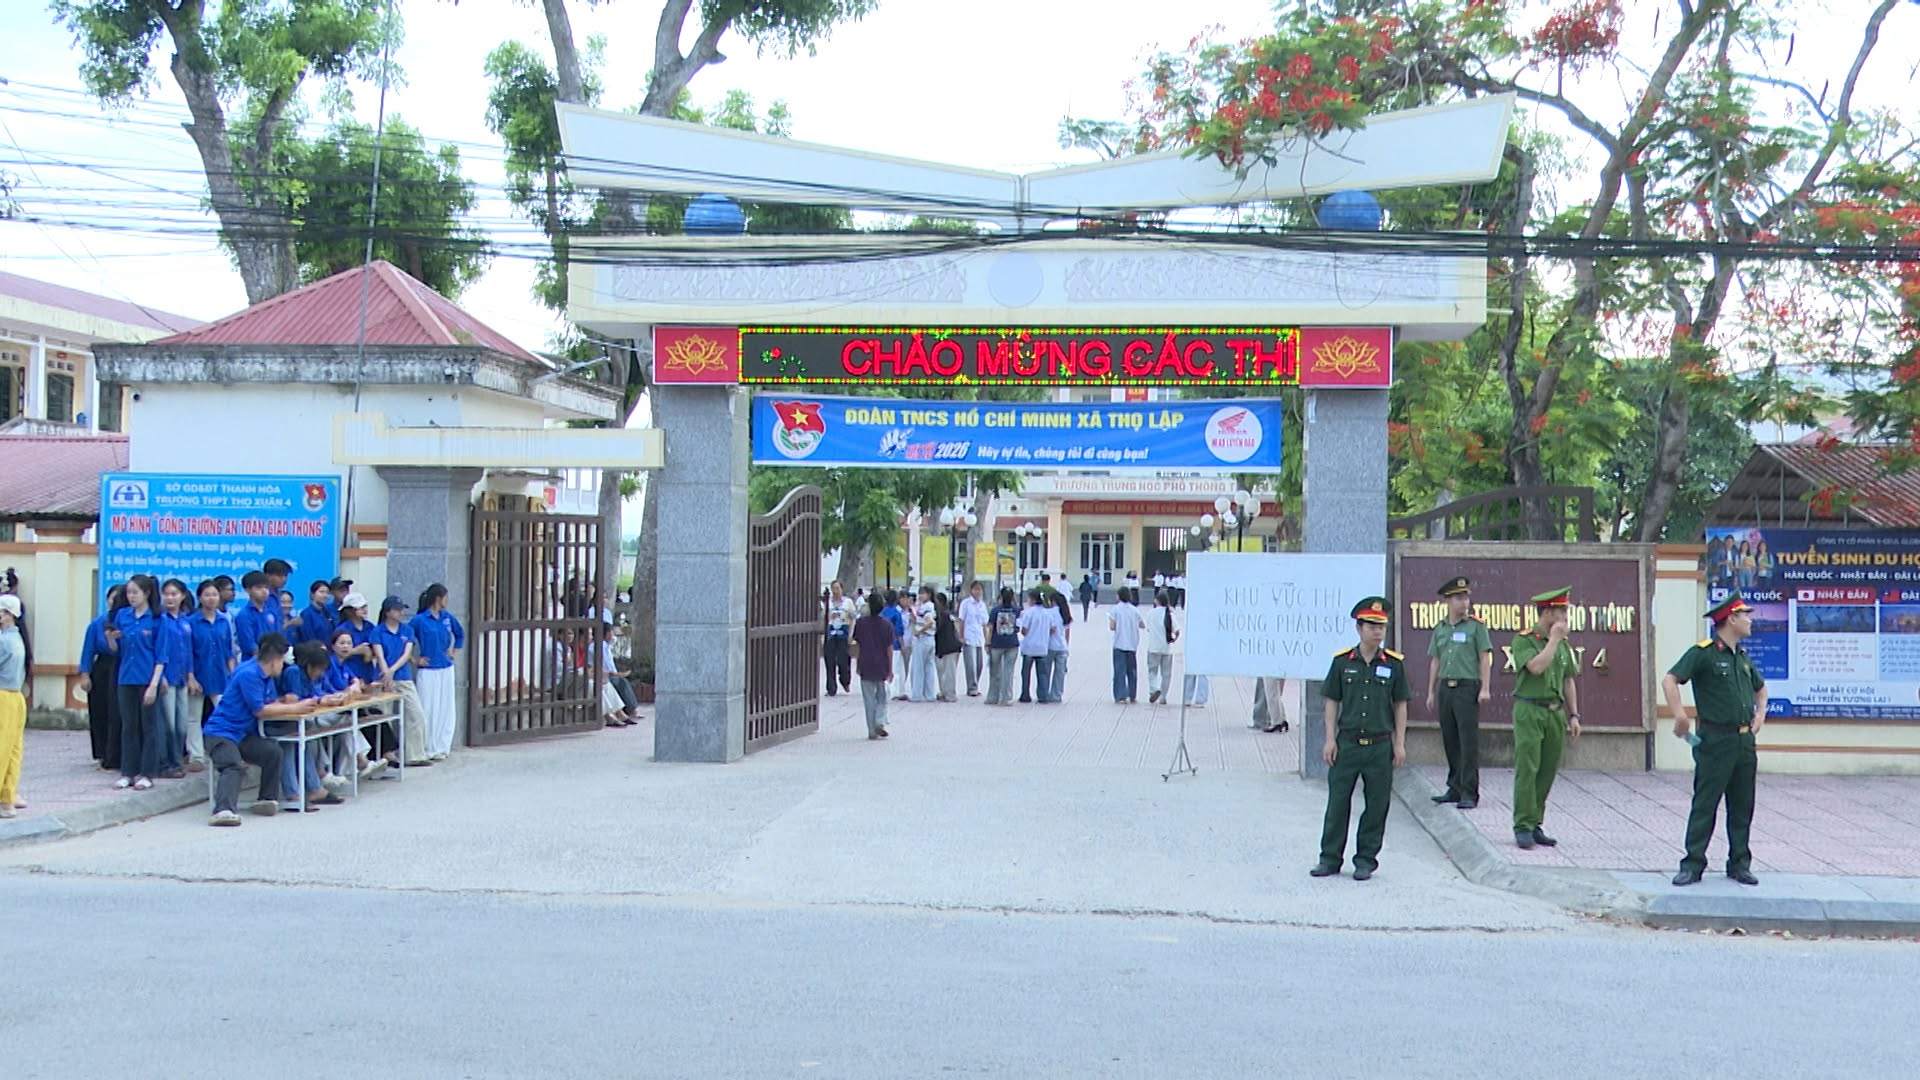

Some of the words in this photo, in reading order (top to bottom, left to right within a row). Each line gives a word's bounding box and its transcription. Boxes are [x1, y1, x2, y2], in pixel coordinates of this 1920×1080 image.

[841, 333, 964, 376] CHÀO
[976, 332, 1111, 376] MỪNG
[1122, 332, 1214, 376] CÁC
[844, 406, 896, 425] ĐOÀN
[901, 409, 949, 426] TNCS
[984, 409, 1016, 427] CHÍ
[1021, 411, 1072, 428] MINH
[1077, 410, 1102, 429] XÃ
[1108, 412, 1143, 432] THỌ
[1148, 409, 1184, 431] LẬP
[933, 441, 971, 459] 2026
[1123, 447, 1149, 463] bạn!
[221, 484, 257, 494] THANH
[202, 496, 228, 505] THPT
[285, 499, 292, 507] 4
[186, 514, 223, 536] TRƯỜNG
[225, 519, 238, 536] AN
[240, 515, 265, 536] TOÀN
[267, 519, 289, 537] GIAO
[1776, 544, 1829, 566] TUYỂN
[1831, 553, 1871, 566] SINH
[1873, 553, 1899, 566] DU
[1901, 553, 1920, 569] HỌ
[1224, 586, 1260, 607] KHU
[1313, 586, 1342, 609] THI
[1753, 589, 1783, 602] QUỐC
[1410, 600, 1449, 630] TRƯ
[1472, 604, 1521, 631] TRUNG
[1593, 648, 1609, 675] 4
